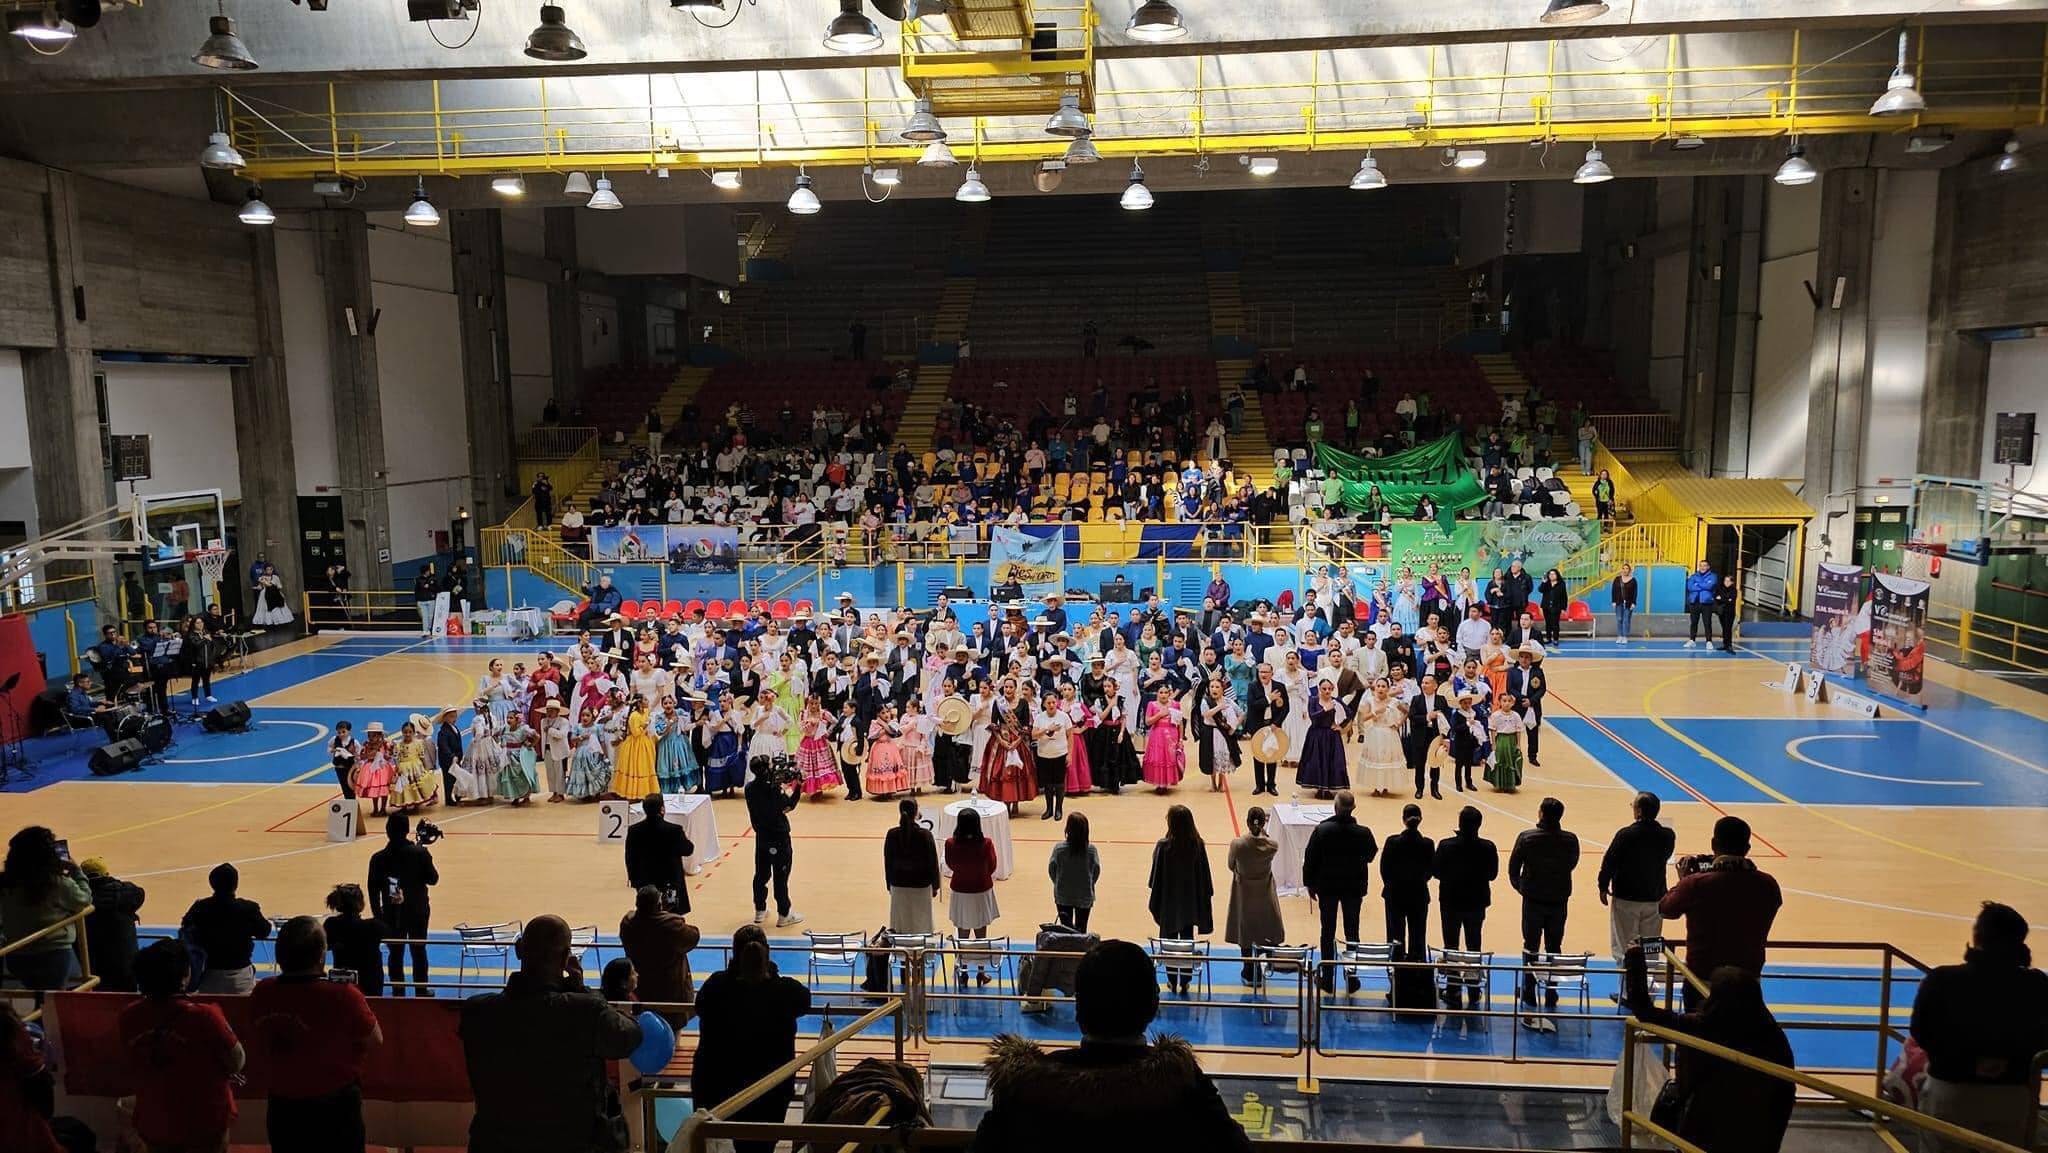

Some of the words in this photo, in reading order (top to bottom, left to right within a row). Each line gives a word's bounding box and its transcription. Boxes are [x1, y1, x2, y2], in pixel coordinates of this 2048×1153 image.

[1809, 680, 1818, 698] 3
[342, 812, 351, 837] 1
[607, 813, 622, 839] 2
